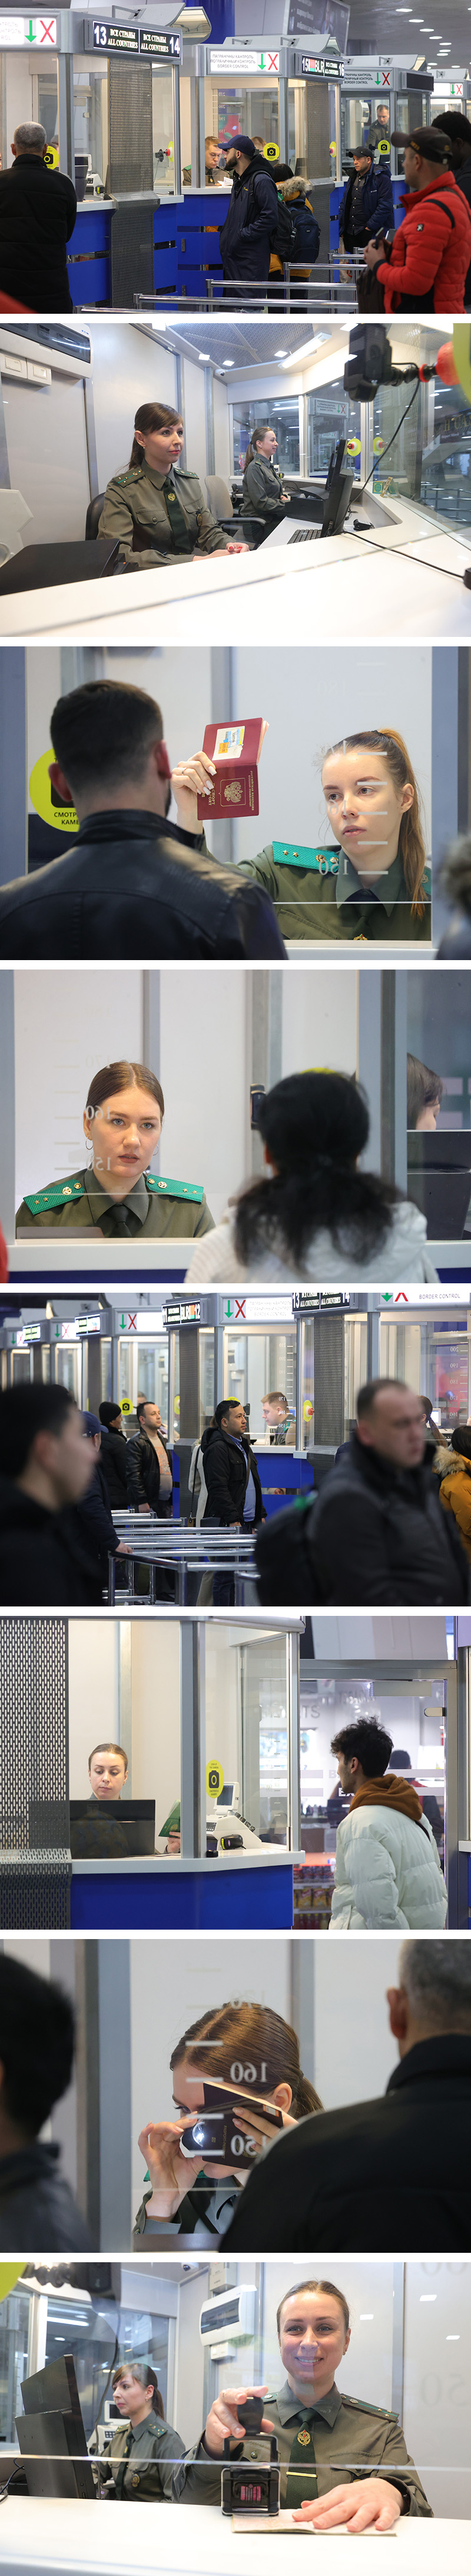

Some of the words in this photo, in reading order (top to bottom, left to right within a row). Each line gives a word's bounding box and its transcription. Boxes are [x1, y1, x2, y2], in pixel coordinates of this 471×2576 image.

[94, 25, 107, 45] 13
[119, 30, 135, 39] СТРАНЫ
[151, 35, 167, 44] СТРАНЫ
[117, 39, 138, 49] COUNTRIES
[149, 44, 169, 52] COUNTRIES
[170, 36, 180, 54] 14
[302, 58, 309, 72] 15
[315, 60, 324, 74] BLR
[339, 64, 344, 77] 16
[293, 1293, 300, 1308] 13
[195, 1304, 200, 1319] 12
